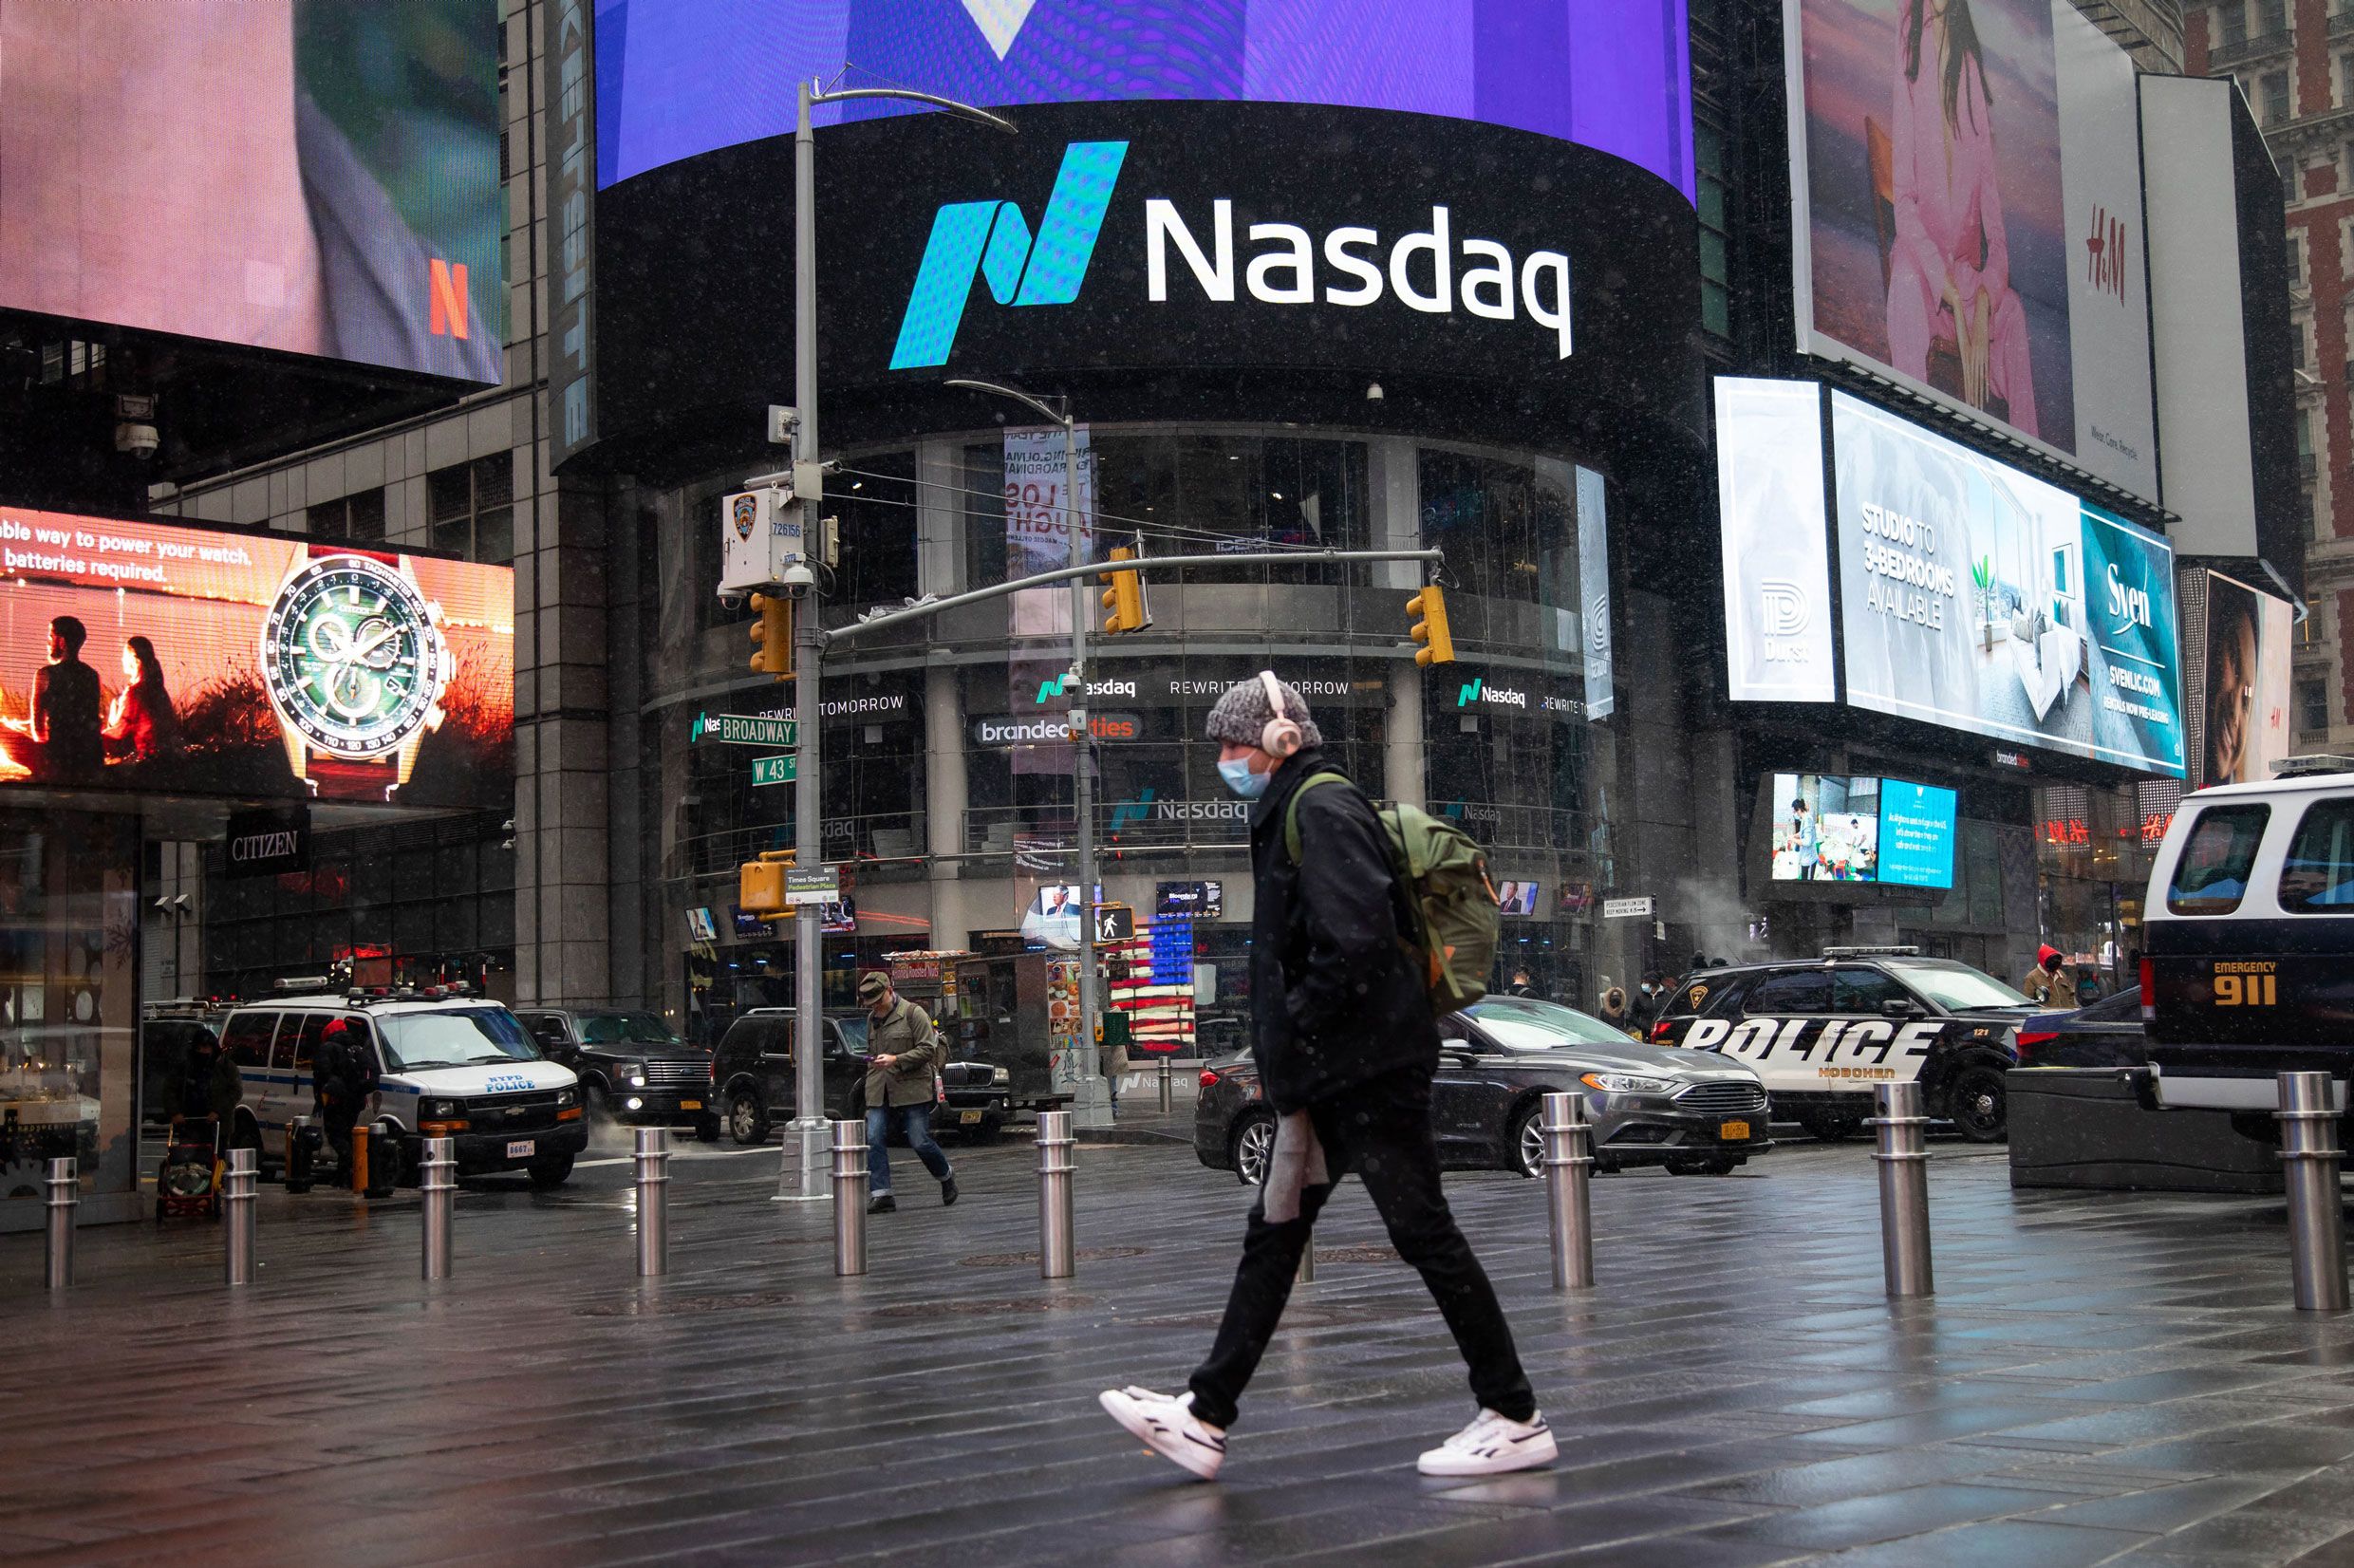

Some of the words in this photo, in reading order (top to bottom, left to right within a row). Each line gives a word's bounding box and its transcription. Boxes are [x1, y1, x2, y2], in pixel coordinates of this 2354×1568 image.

[2086, 204, 2125, 308] H&M
[1144, 198, 1572, 359] Nasdaq
[430, 258, 468, 340] N
[773, 523, 800, 537] 726156
[1861, 500, 1915, 547] STUDIO
[1916, 520, 1935, 554] TO
[35, 529, 71, 548] way
[76, 532, 94, 547] to
[99, 536, 153, 553] power
[158, 542, 194, 558] your
[199, 545, 252, 566] watch.
[5, 548, 85, 574] batteries
[90, 562, 167, 583] required.
[1864, 540, 1953, 598] 3-BEDROOMS
[285, 585, 298, 599] 70
[2108, 563, 2152, 634] Sven
[1867, 581, 1942, 631] AVAILABLE
[1087, 678, 1136, 699] asdaq
[2110, 665, 2160, 699] SVENLIC.COM
[819, 696, 904, 716] TOMORROW
[1482, 686, 1525, 708] Nasdaq
[723, 719, 793, 743] BROADWAY
[756, 761, 765, 782] W
[769, 759, 785, 780] 43
[1158, 797, 1248, 824] Nasdaq
[233, 830, 297, 862] CITIZEN
[808, 875, 830, 884] Square
[2214, 962, 2276, 973] EMERGENCY
[2214, 975, 2276, 1006] 911
[1681, 1019, 1945, 1064] POLICE
[1973, 1028, 1990, 1036] 121
[488, 1074, 523, 1083] NYPD
[1143, 1076, 1187, 1089] Naaq
[1818, 1067, 1895, 1079] HOBOKEN
[485, 1080, 535, 1093] POLICE
